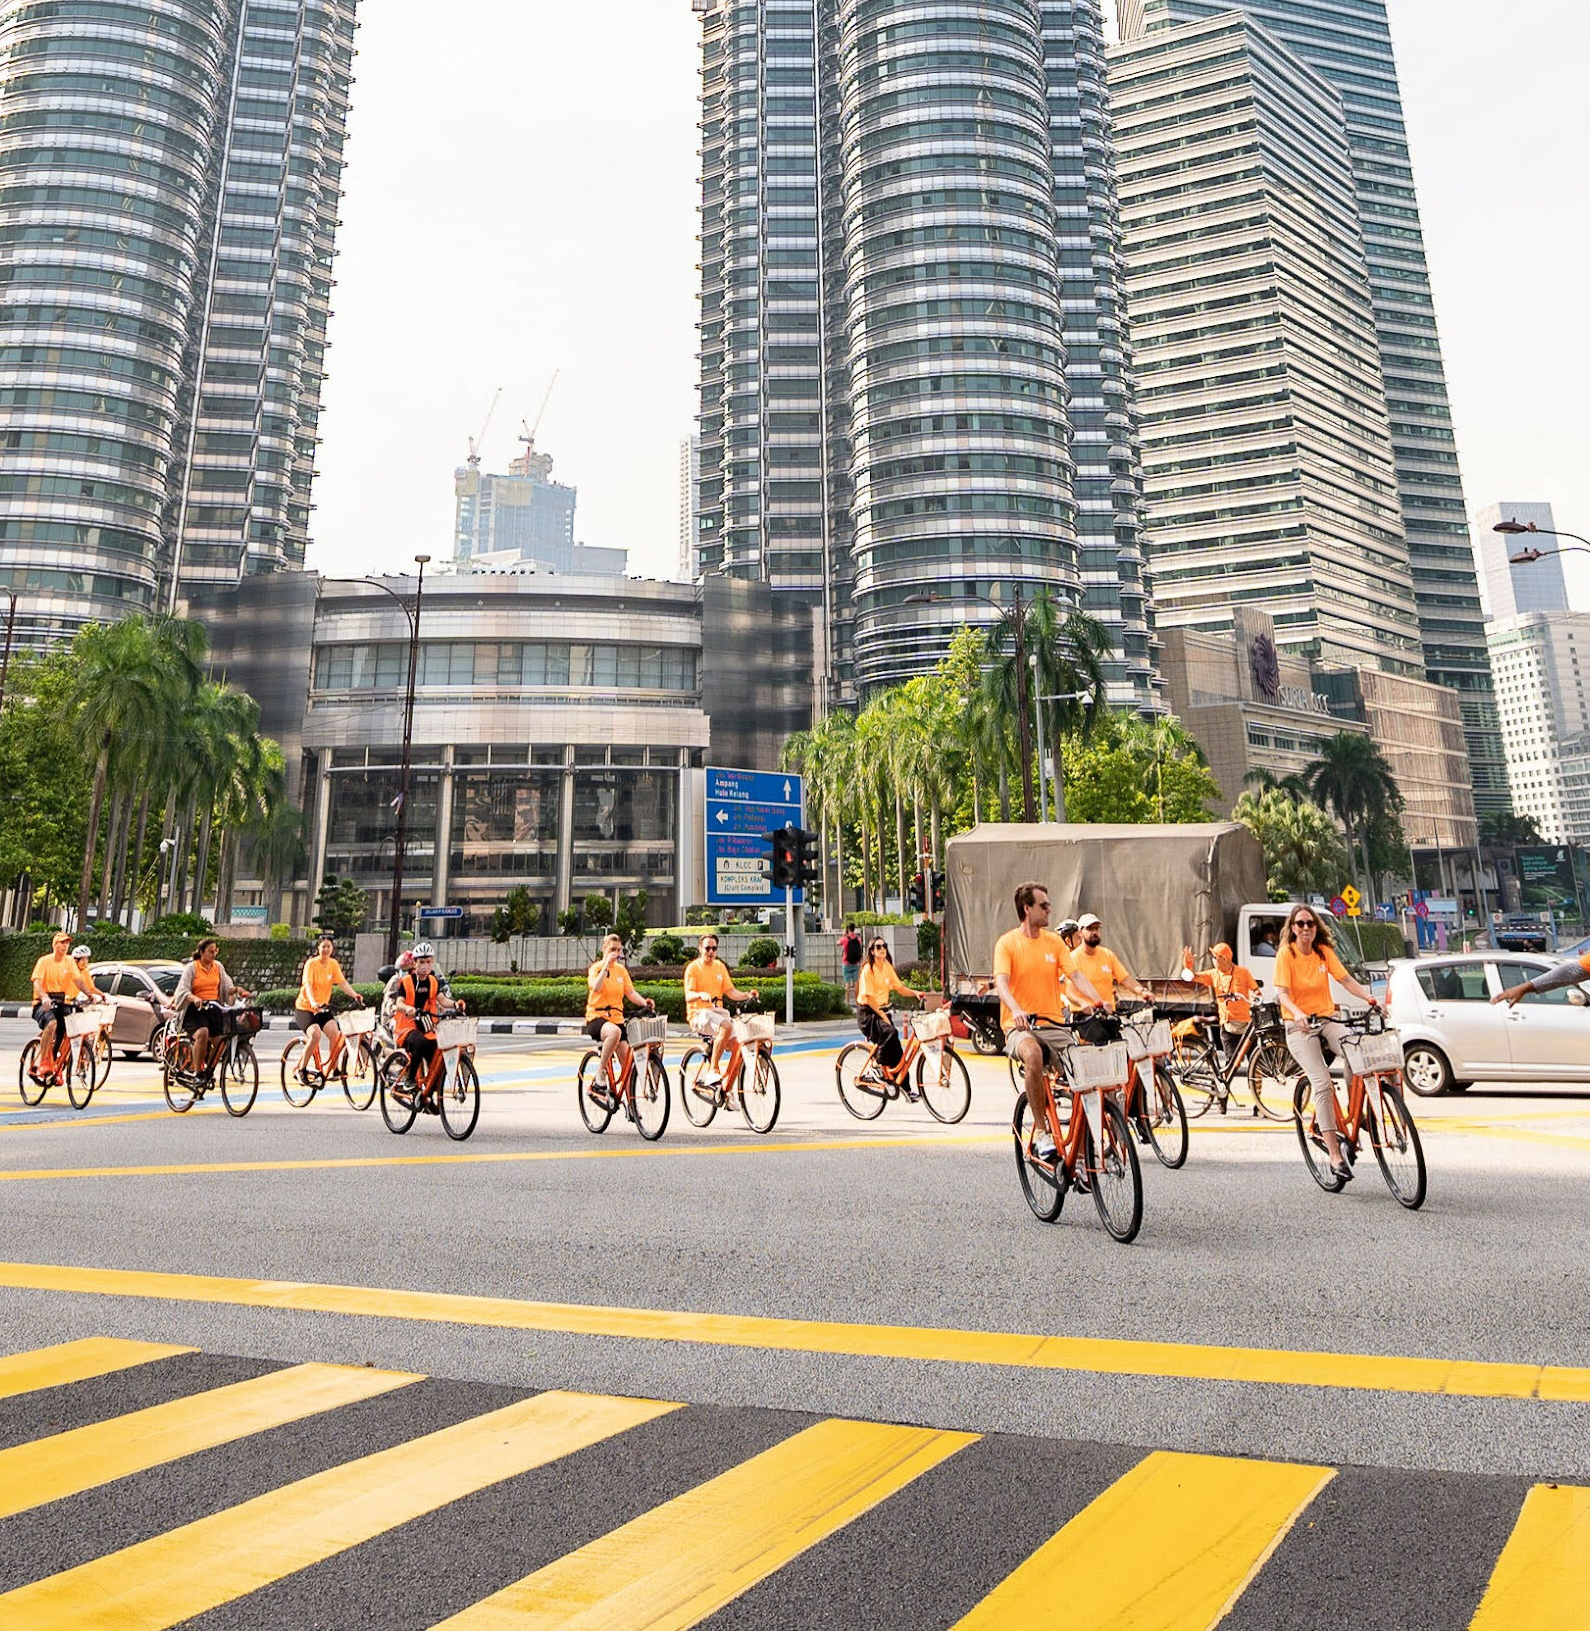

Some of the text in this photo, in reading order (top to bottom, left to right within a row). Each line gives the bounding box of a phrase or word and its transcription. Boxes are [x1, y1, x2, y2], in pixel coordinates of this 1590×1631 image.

[1277, 685, 1309, 710] SURIA
[715, 779, 738, 789] Ampang
[736, 861, 751, 869] KLCC
